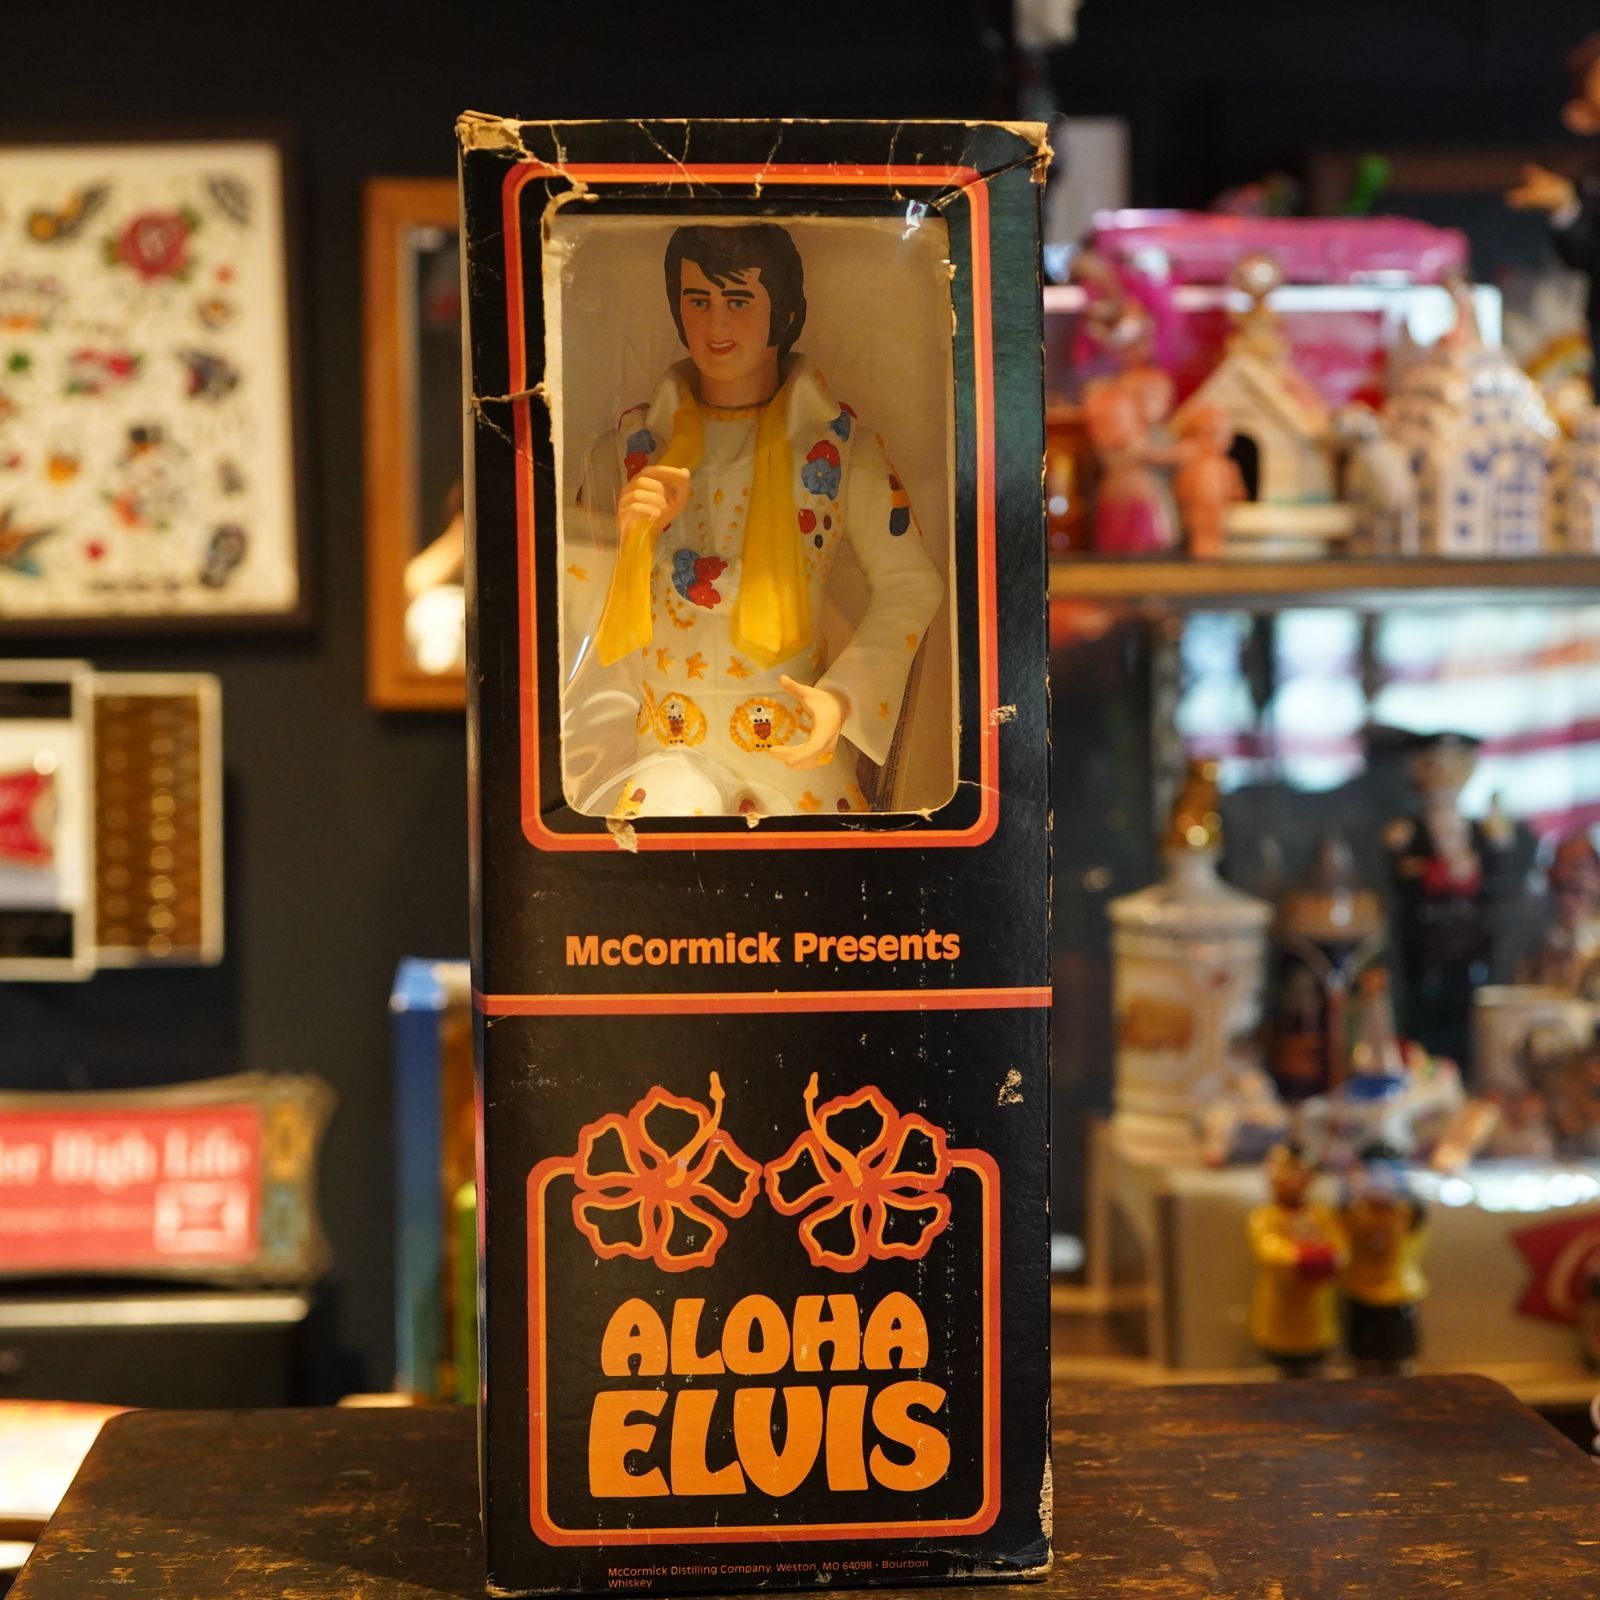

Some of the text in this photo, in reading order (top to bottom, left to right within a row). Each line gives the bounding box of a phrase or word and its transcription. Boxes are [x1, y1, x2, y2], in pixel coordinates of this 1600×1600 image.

[566, 929, 961, 967] McCormick Presents
[600, 1291, 929, 1377] ALOHA
[588, 1380, 951, 1499] ELVIS
[608, 1566, 667, 1577] McCormick
[670, 1565, 718, 1576] Distilling
[720, 1564, 773, 1575] Company,
[822, 1562, 839, 1571] MO
[842, 1560, 873, 1571] 64098
[882, 1559, 929, 1570] Bourbon
[608, 1577, 653, 1589] Whiskey
